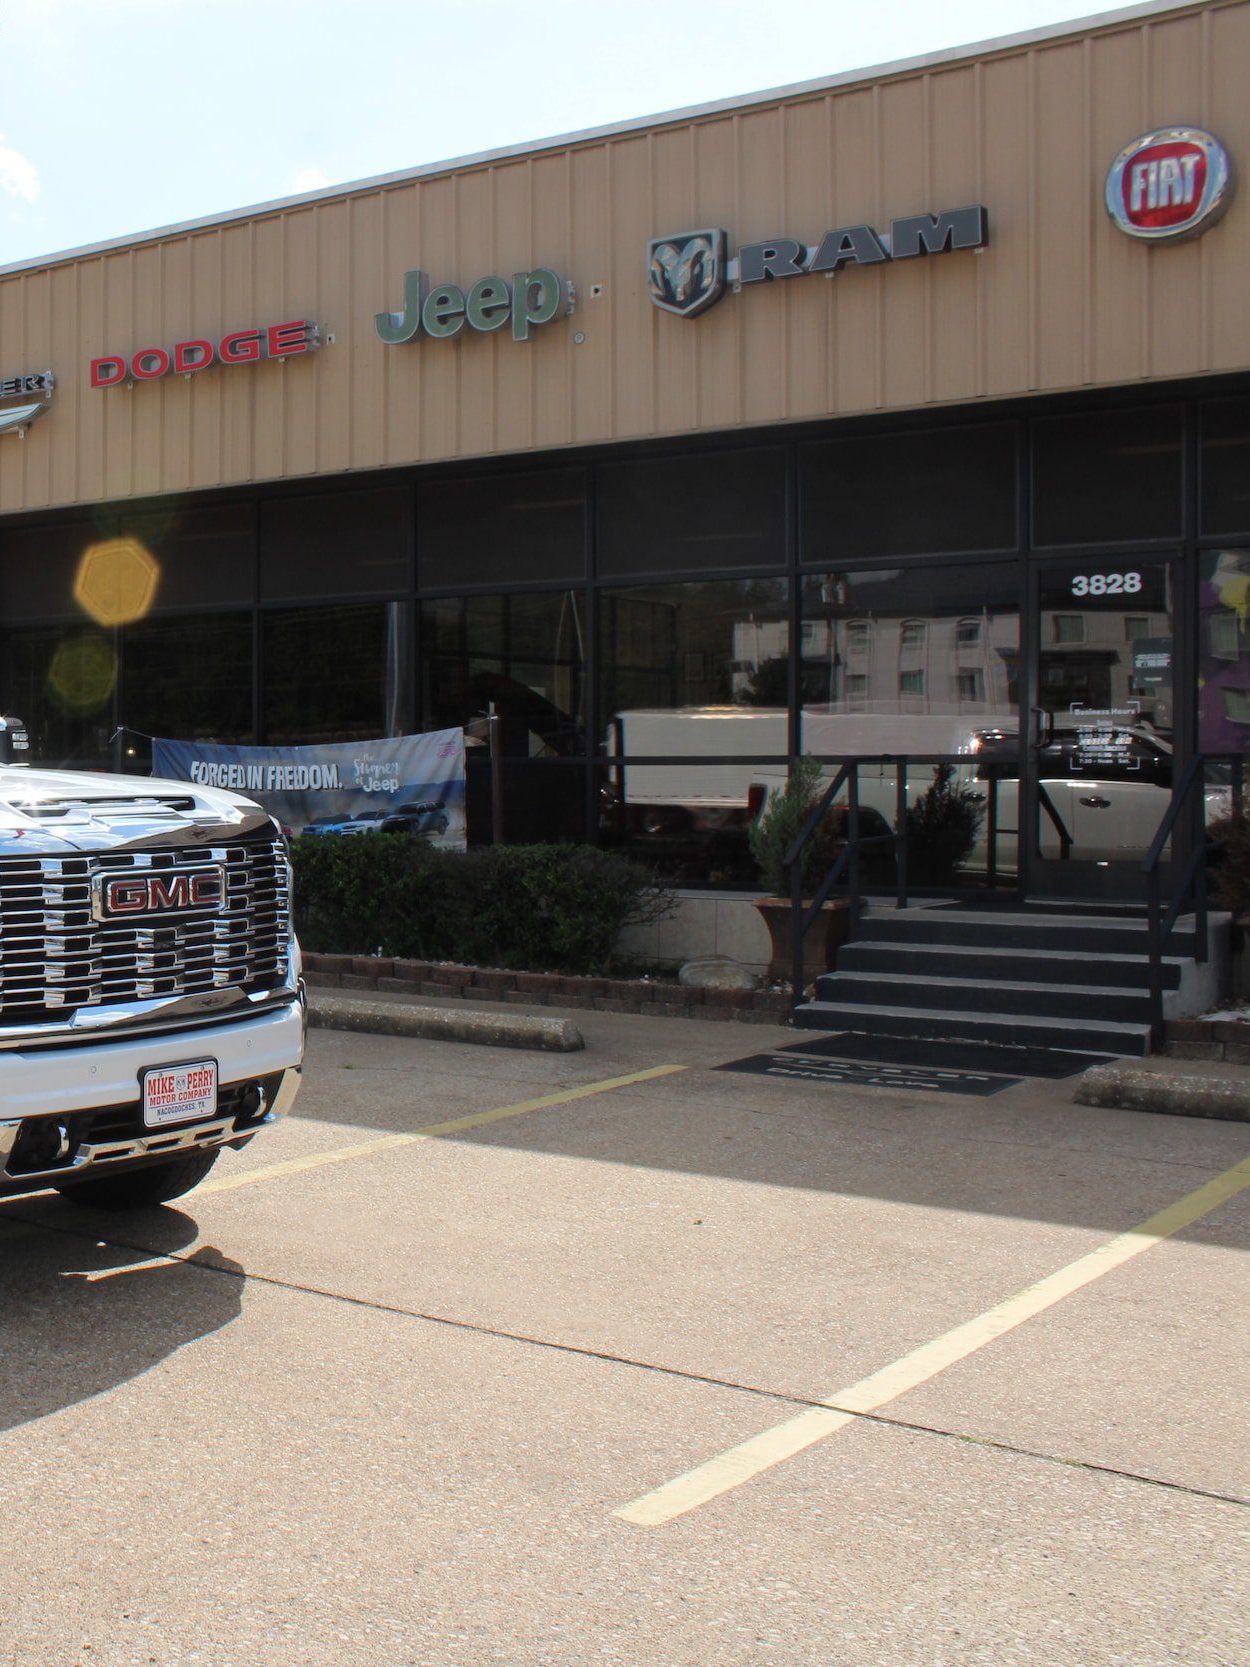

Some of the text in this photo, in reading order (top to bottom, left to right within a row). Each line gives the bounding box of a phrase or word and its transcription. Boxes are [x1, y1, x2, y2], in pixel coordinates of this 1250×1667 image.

[1130, 153, 1201, 212] FIAT
[739, 205, 988, 283] RAM
[374, 268, 562, 344] Jeep
[90, 320, 309, 388] DODGE
[1071, 572, 1142, 597] 3828
[1111, 707, 1136, 715] Hours
[191, 761, 246, 789] FORGED
[247, 765, 263, 790] IN
[363, 777, 399, 793] Jeep
[107, 875, 223, 912] GMC
[148, 1069, 214, 1096] MIKE PERRY
[150, 1087, 212, 1106] MOTOR COMPANY
[198, 1101, 205, 1109] TX
